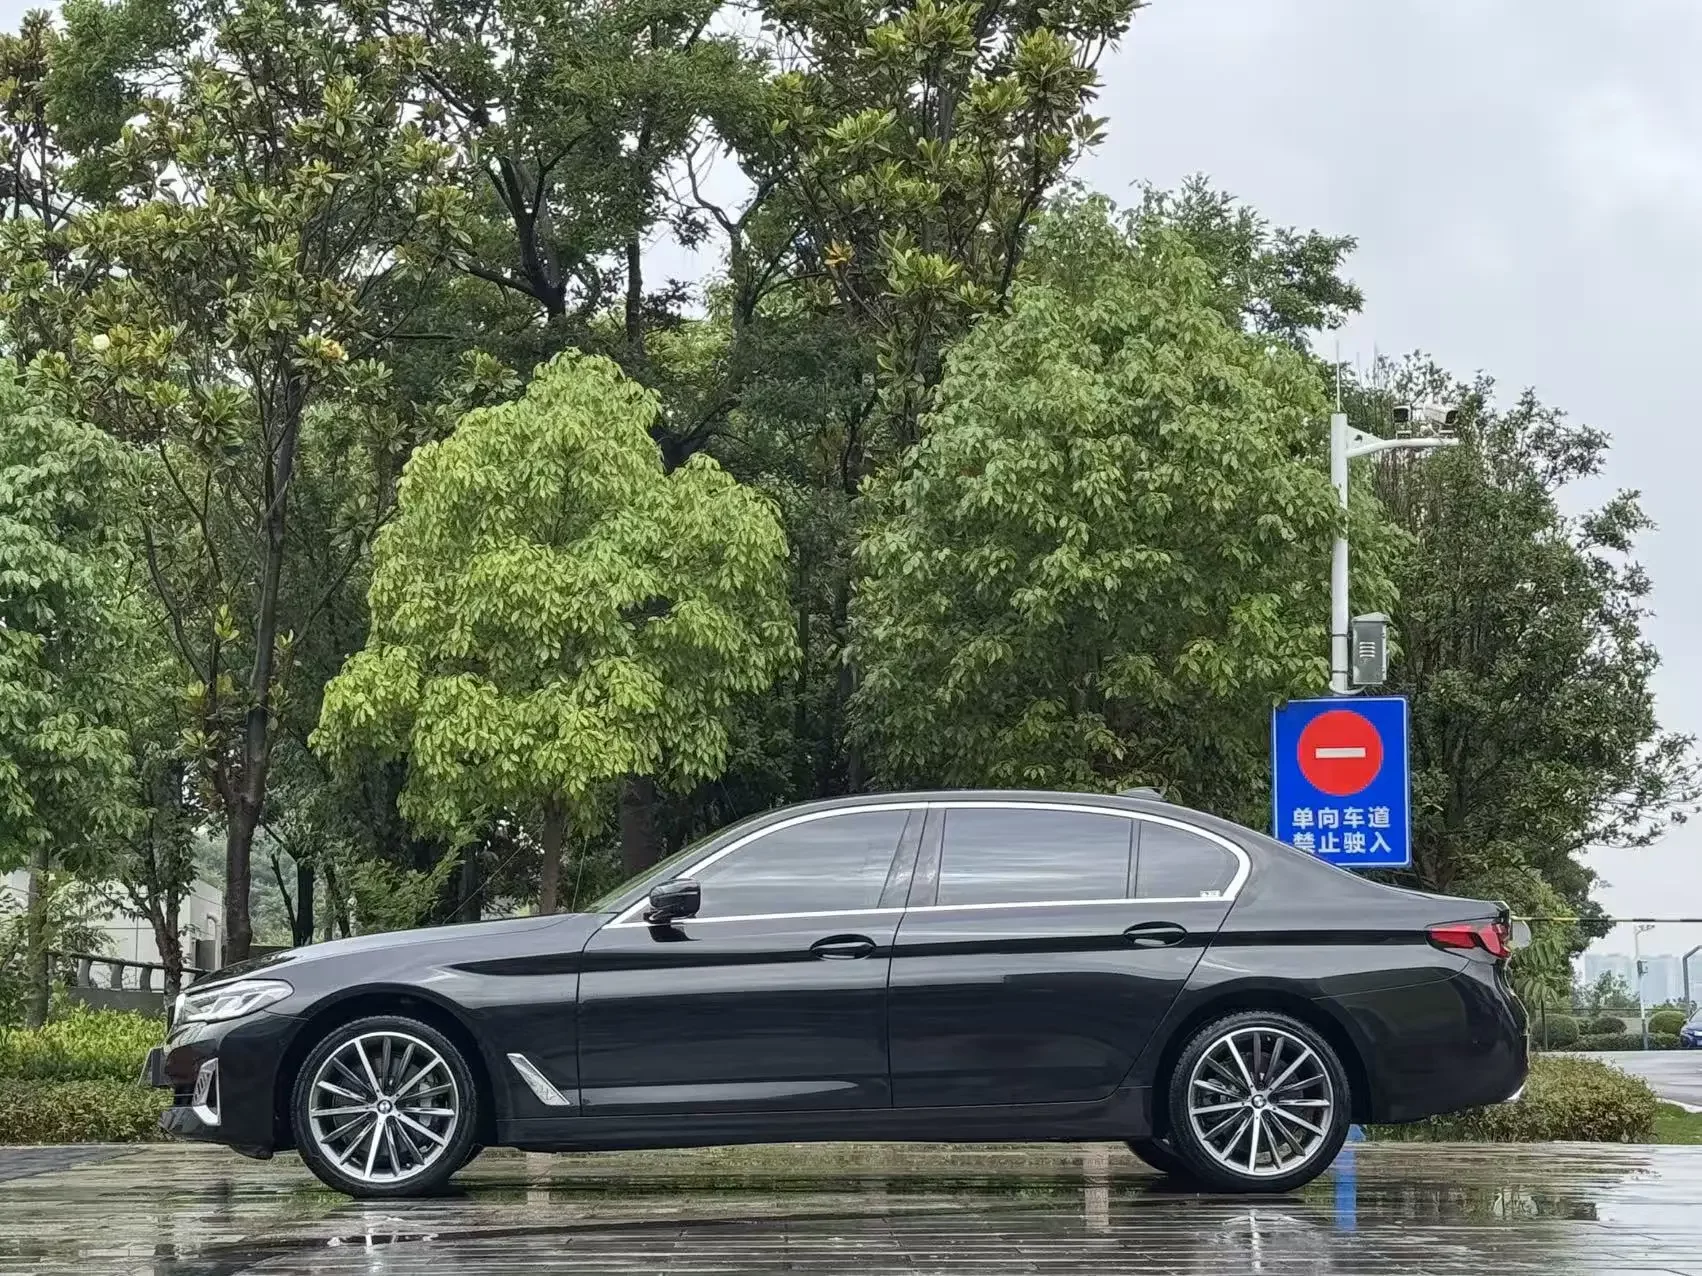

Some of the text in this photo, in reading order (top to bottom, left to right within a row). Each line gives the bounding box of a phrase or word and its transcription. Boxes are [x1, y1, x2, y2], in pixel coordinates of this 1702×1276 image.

[1292, 806, 1391, 829] 单向车道
[1292, 831, 1392, 854] 禁止驶入
